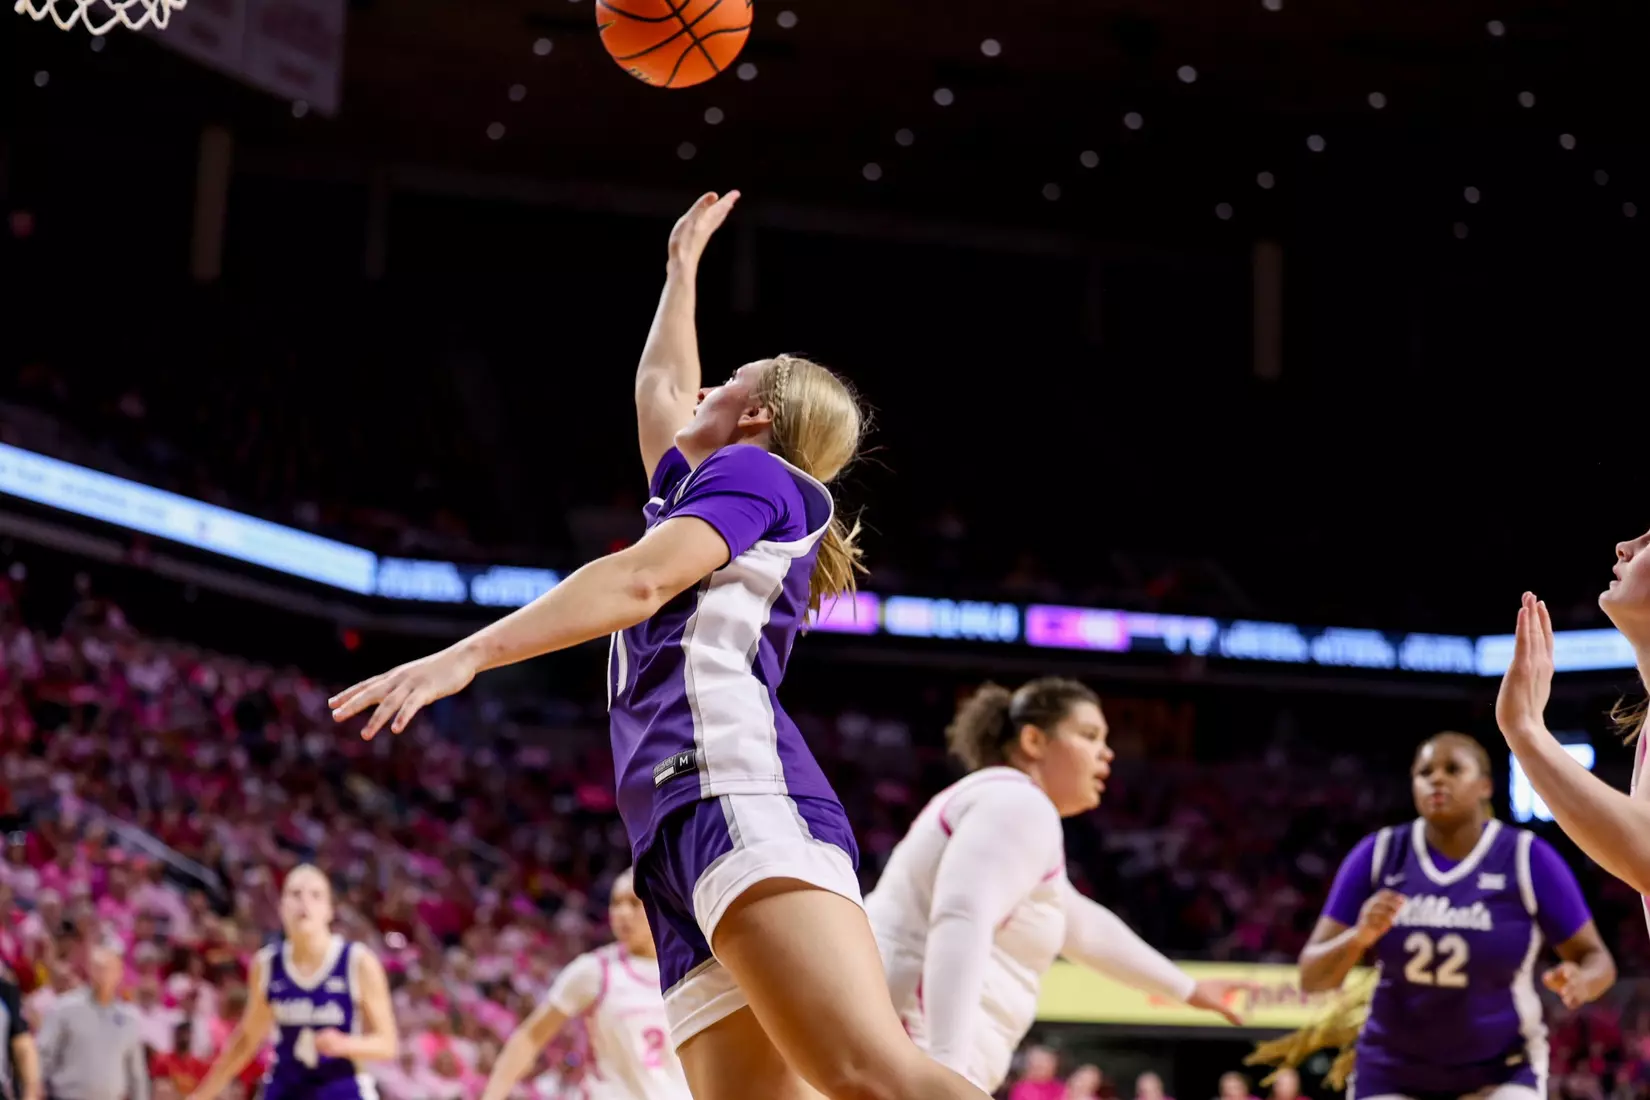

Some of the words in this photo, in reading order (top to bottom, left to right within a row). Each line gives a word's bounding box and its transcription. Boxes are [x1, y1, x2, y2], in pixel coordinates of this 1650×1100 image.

[679, 755, 689, 766] M
[1404, 932, 1469, 988] 22
[293, 1028, 319, 1069] 4
